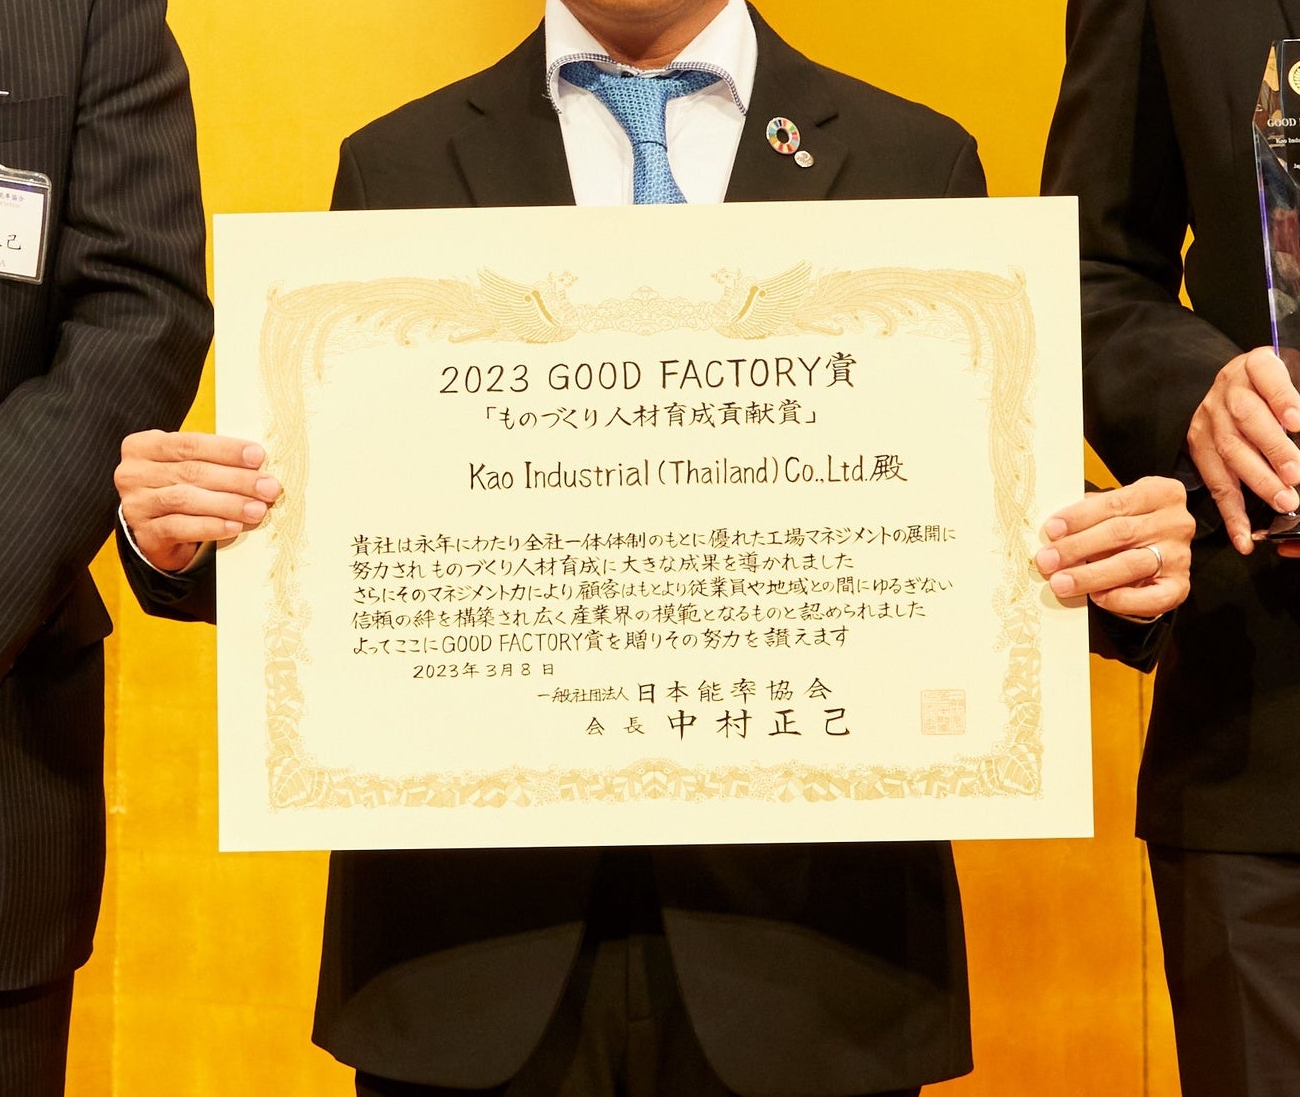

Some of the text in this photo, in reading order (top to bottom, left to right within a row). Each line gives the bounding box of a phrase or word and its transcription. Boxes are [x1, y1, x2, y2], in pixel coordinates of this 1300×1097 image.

[1266, 117, 1297, 128] GOOD
[439, 351, 857, 394] 2023 GOOD FACTORY賞
[485, 398, 817, 431] 「ものづくり人材育成貢献賞」
[468, 462, 514, 491] Kao
[524, 458, 649, 489] Industrial
[658, 456, 779, 486] (Thailand)
[537, 676, 834, 705] 一般社団法人 日本能率協会
[585, 707, 851, 742] 会長 中村正己
